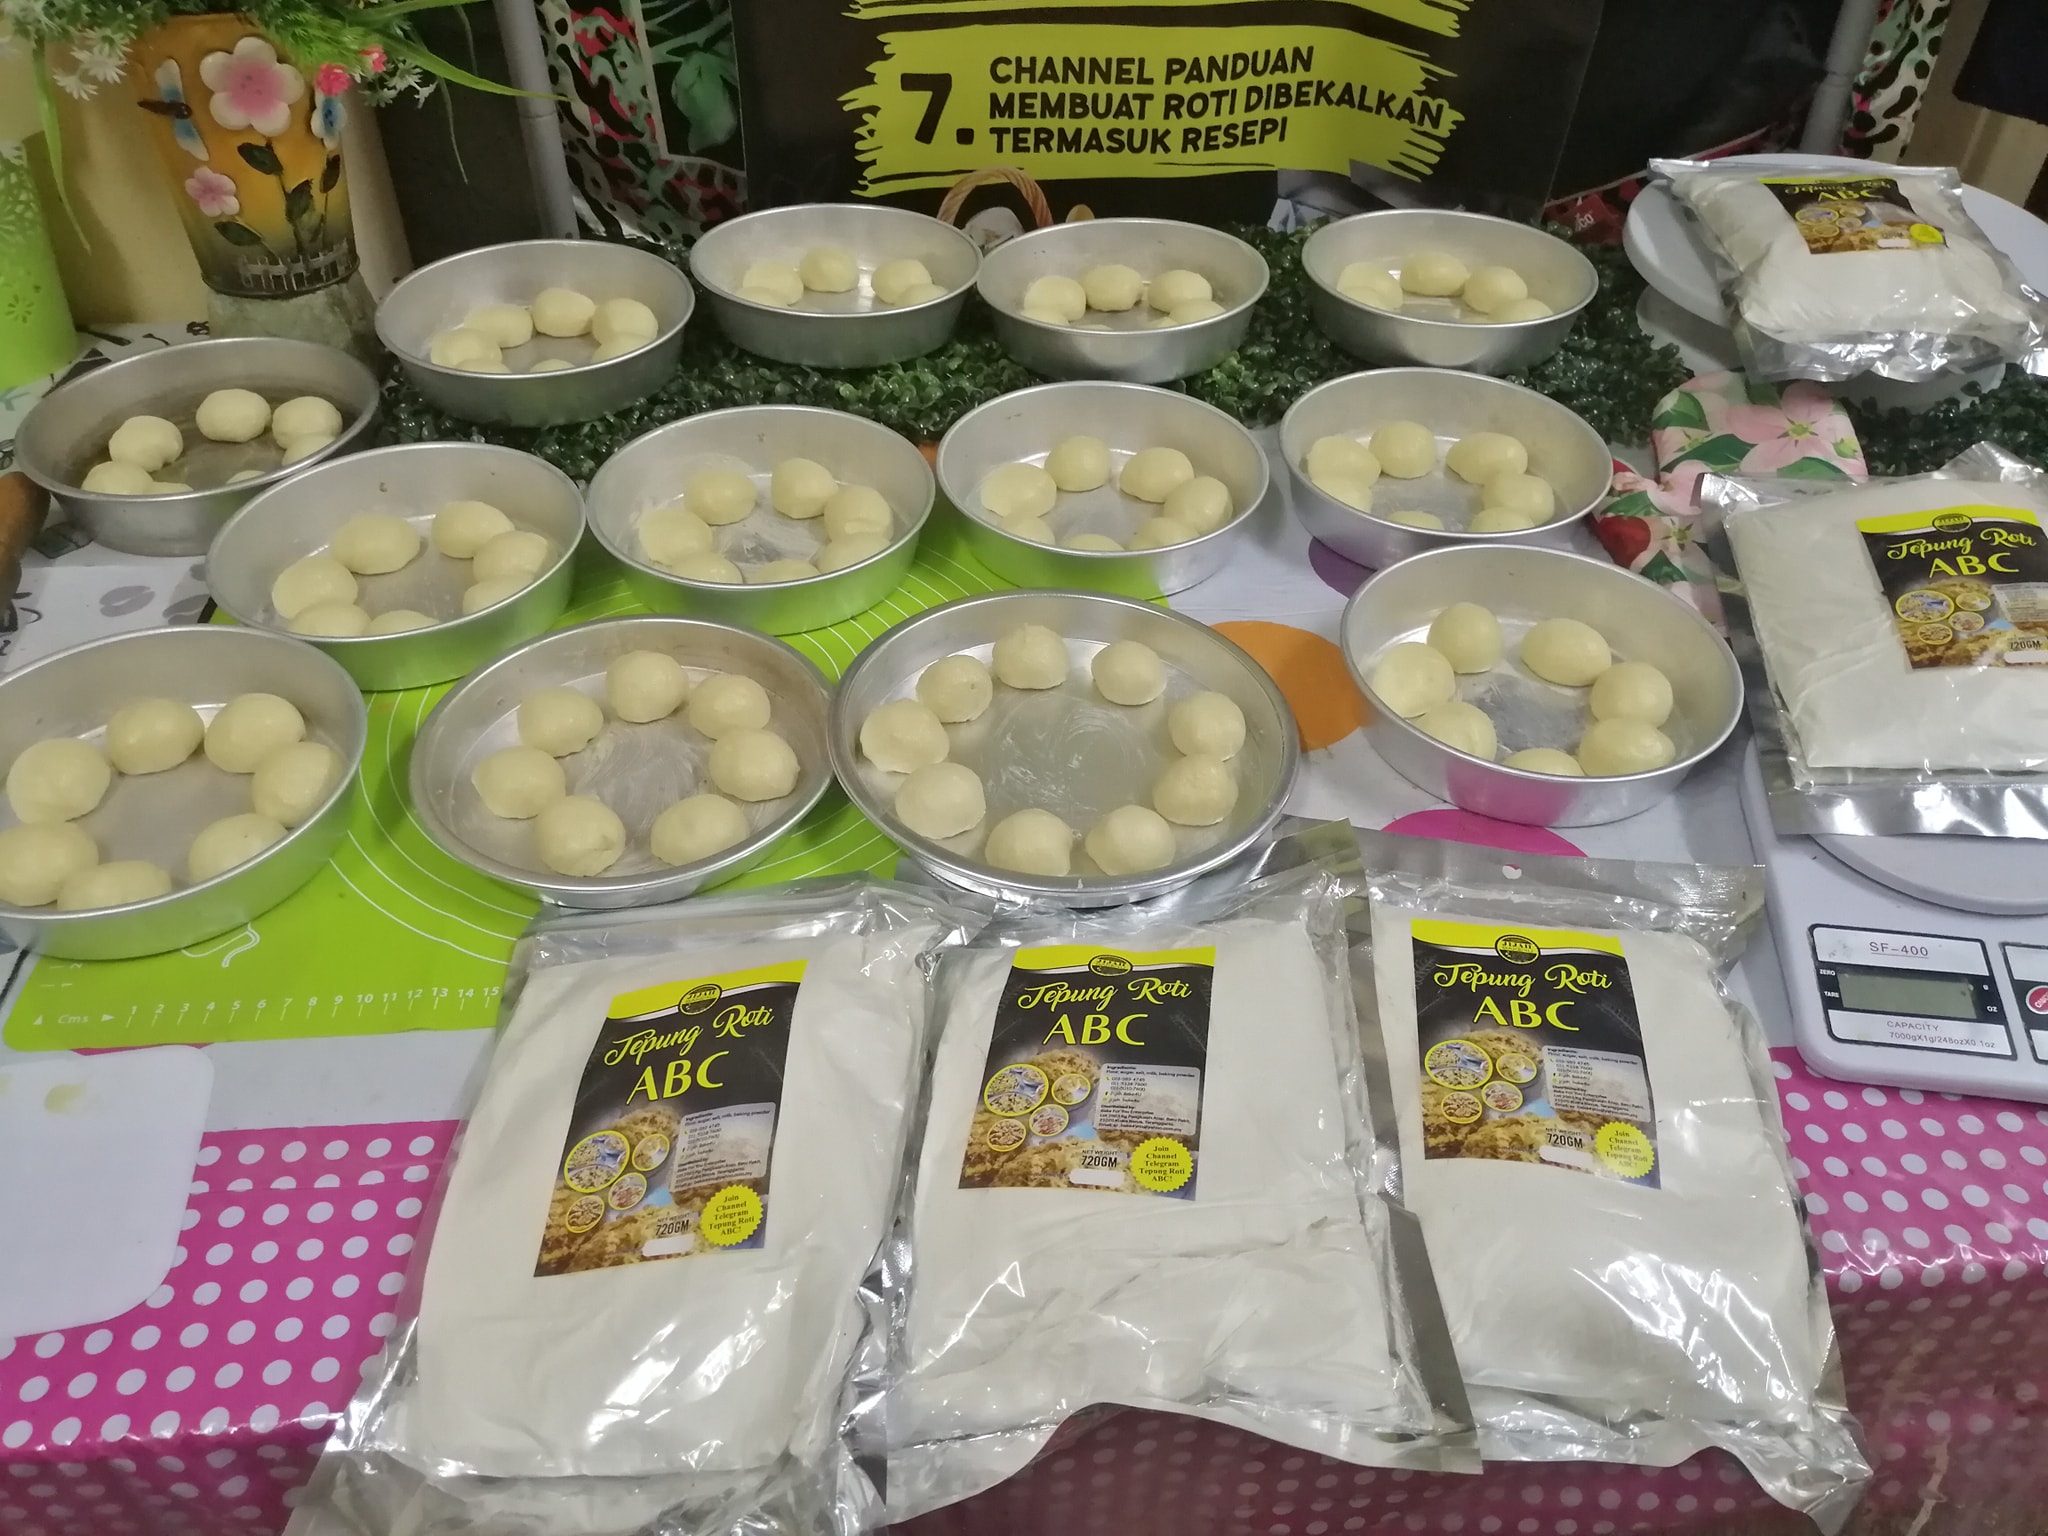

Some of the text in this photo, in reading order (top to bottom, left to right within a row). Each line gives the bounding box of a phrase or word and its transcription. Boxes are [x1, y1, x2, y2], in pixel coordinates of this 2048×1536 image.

[989, 45, 1315, 86] CHANNEL PANDUAN
[900, 73, 976, 146] 7.
[988, 79, 1445, 131] MEMBUAT ROTI DIBEKALKAN
[988, 117, 1289, 155] TERMASUK RESEPI
[1817, 189, 1885, 202] ABC
[1886, 527, 2038, 560] Tepung Roti
[1928, 551, 2020, 579] ABC
[1869, 940, 1930, 957] SF-400
[1432, 962, 1614, 998] Tepung Roti
[1819, 968, 1836, 976] ZERO
[57, 986, 500, 1025] Cms 1 2 3 4 5 6 7 8 9 10 11 12 13 14 15
[1016, 976, 1193, 1013] Tepung Roti
[1472, 995, 1581, 1032] ABC
[603, 1003, 776, 1067] Tepung Roti
[1042, 1012, 1149, 1046] ABC
[1886, 1020, 1940, 1032] CAPACITY
[625, 1050, 730, 1106] ABC
[1546, 1132, 1584, 1149] 720GM
[1081, 1155, 1118, 1168] 720GM
[1139, 1167, 1168, 1175] Tepung
[1144, 1160, 1180, 1168] Telegram
[715, 1200, 747, 1213] Channel
[723, 1194, 739, 1204] Join
[709, 1220, 737, 1231] Tepung
[714, 1210, 749, 1221] Telegram
[655, 1219, 690, 1236] 720GM
